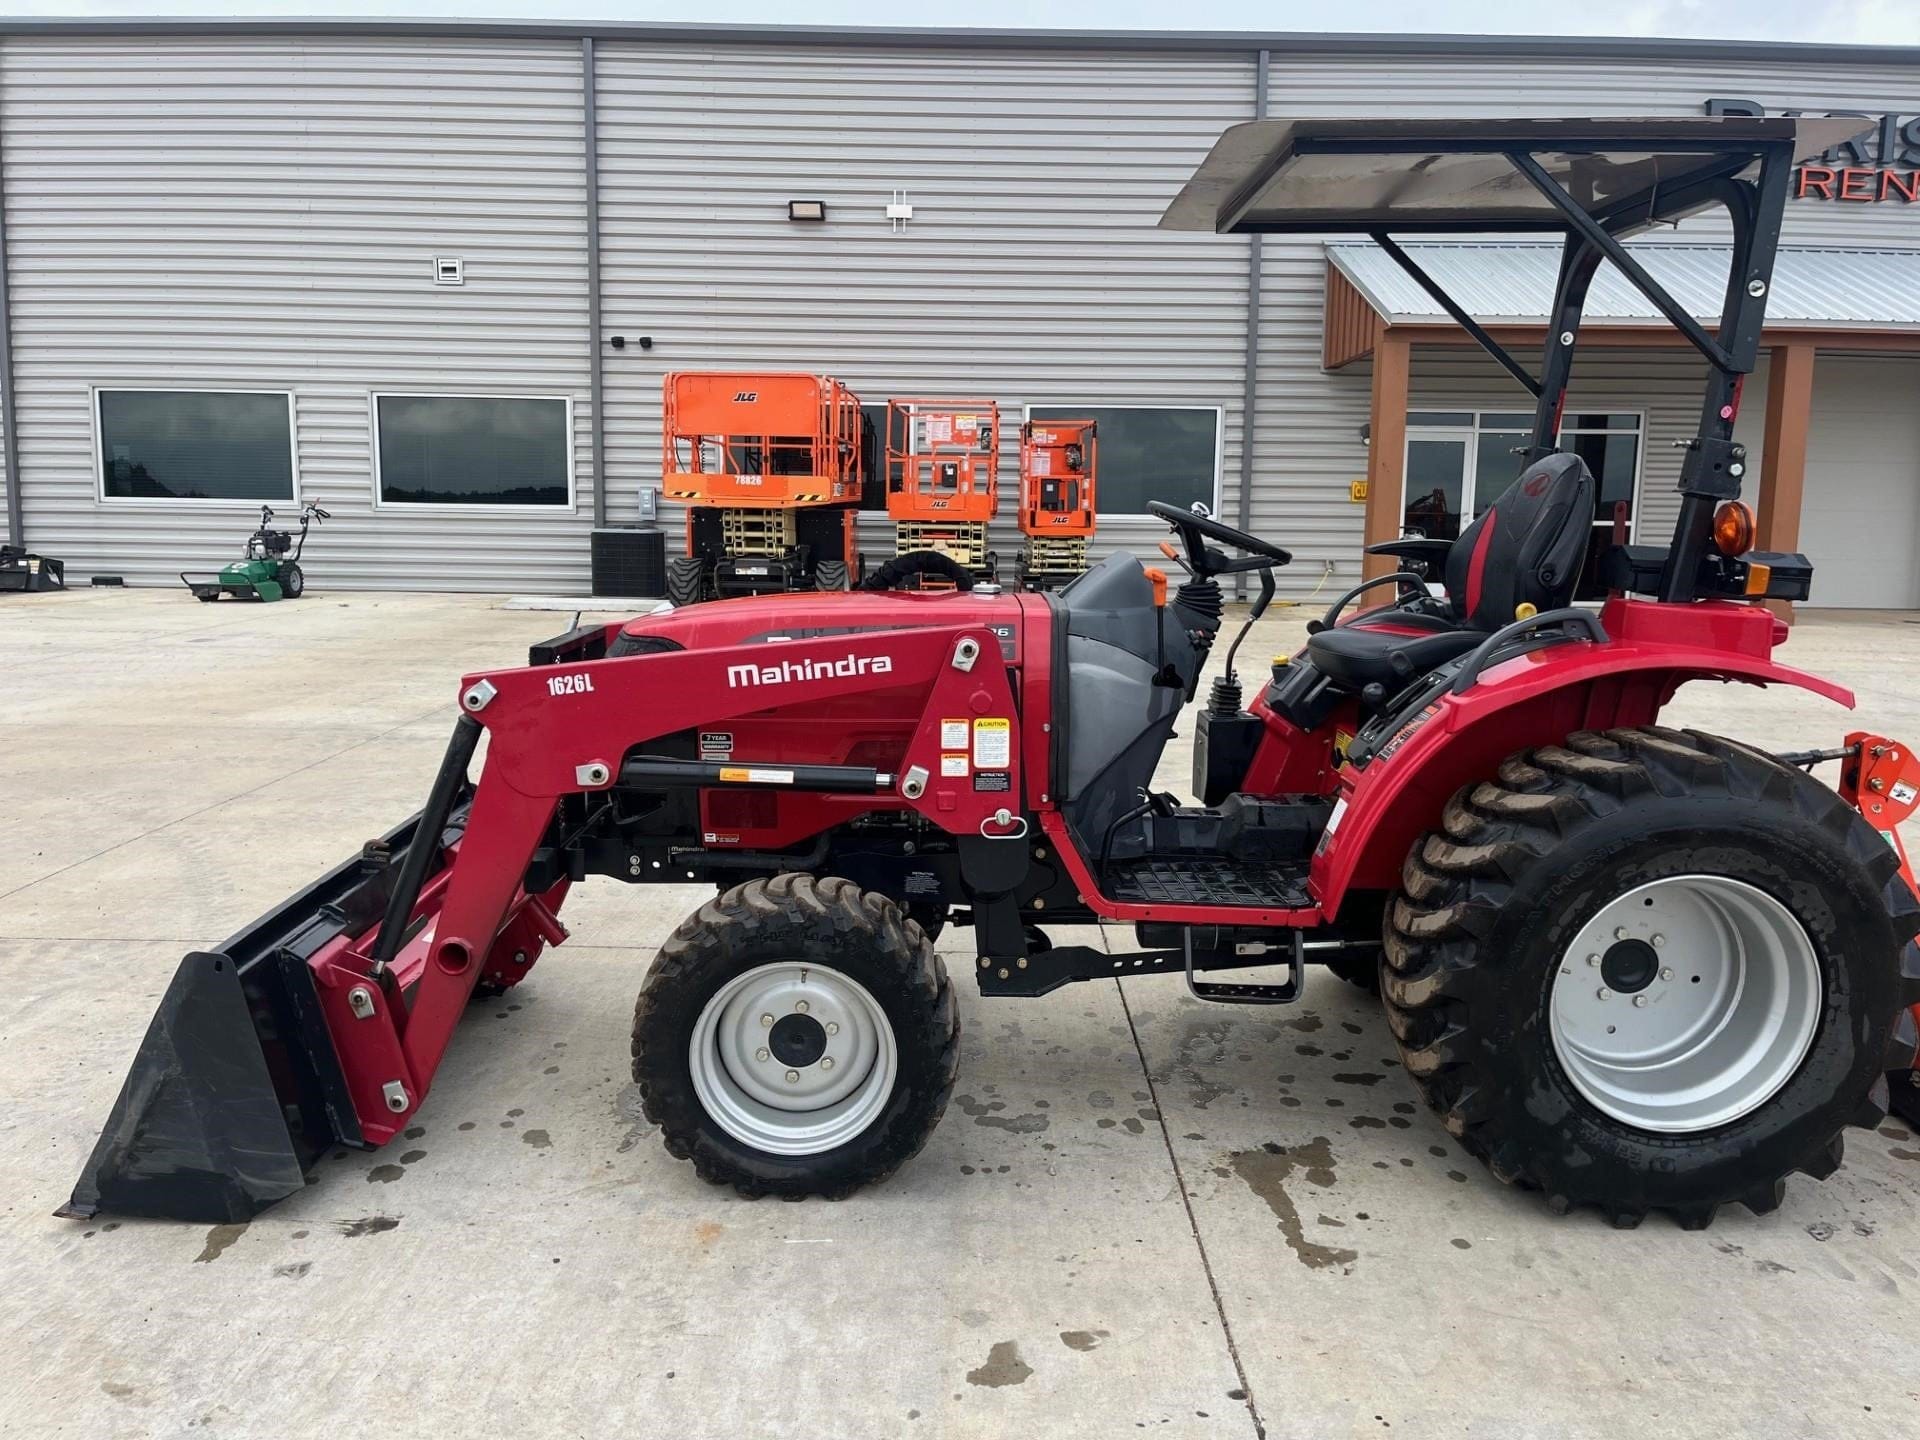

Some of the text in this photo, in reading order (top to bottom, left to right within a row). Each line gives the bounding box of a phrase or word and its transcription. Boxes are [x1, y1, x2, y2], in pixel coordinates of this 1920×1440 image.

[1795, 166, 1920, 201] REN
[733, 392, 757, 402] JLG
[1052, 516, 1068, 524] JLG
[727, 654, 892, 688] Mahindra
[546, 673, 594, 696] 1626L
